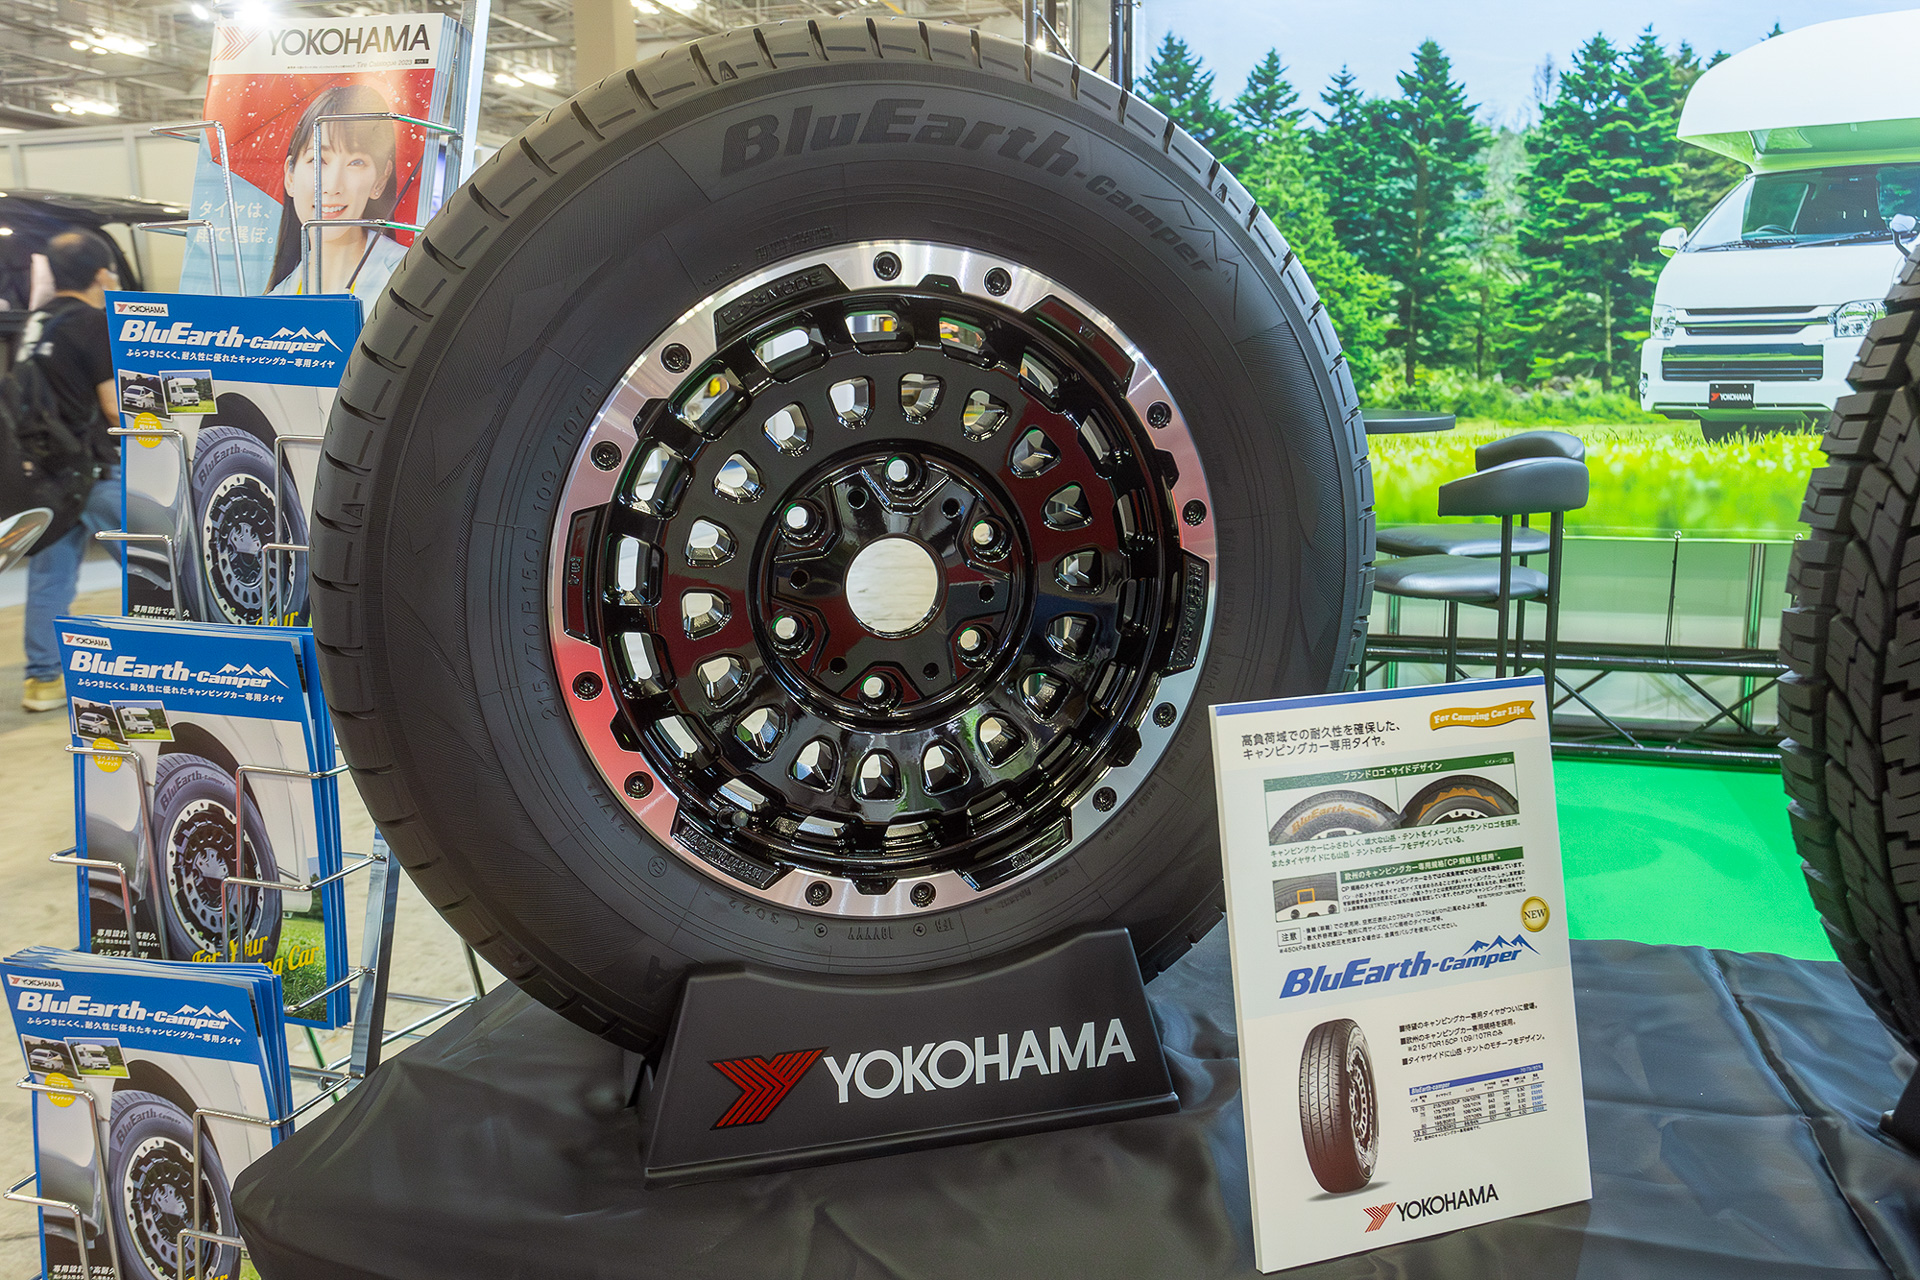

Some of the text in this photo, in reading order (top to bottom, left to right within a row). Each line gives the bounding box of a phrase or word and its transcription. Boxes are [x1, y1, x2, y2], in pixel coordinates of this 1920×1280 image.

[268, 24, 431, 55] YOKOHAMA
[398, 59, 413, 67] 2023
[128, 304, 166, 315] YOKOHAMA
[1720, 392, 1752, 402] YOKOHAMA
[133, 605, 190, 618] 専用設計で高久
[74, 636, 109, 648] YOKOHAMA
[1434, 705, 1526, 724] For Camping Car Life
[1241, 720, 1400, 747] 高負荷域での耐久性を確保した、
[1243, 734, 1386, 761] キャンピングカー専用タイヤ。
[1342, 762, 1443, 780] ブランドロゴ・サイドデザイン
[1524, 908, 1546, 919] NEW
[1281, 932, 1298, 942] 注意
[229, 935, 269, 962] Yur
[288, 945, 320, 971] Car
[21, 978, 62, 990] YOKOHAMA
[823, 1018, 1136, 1104] YOKOHAMA
[1396, 1183, 1499, 1222] YOKOHAMA
